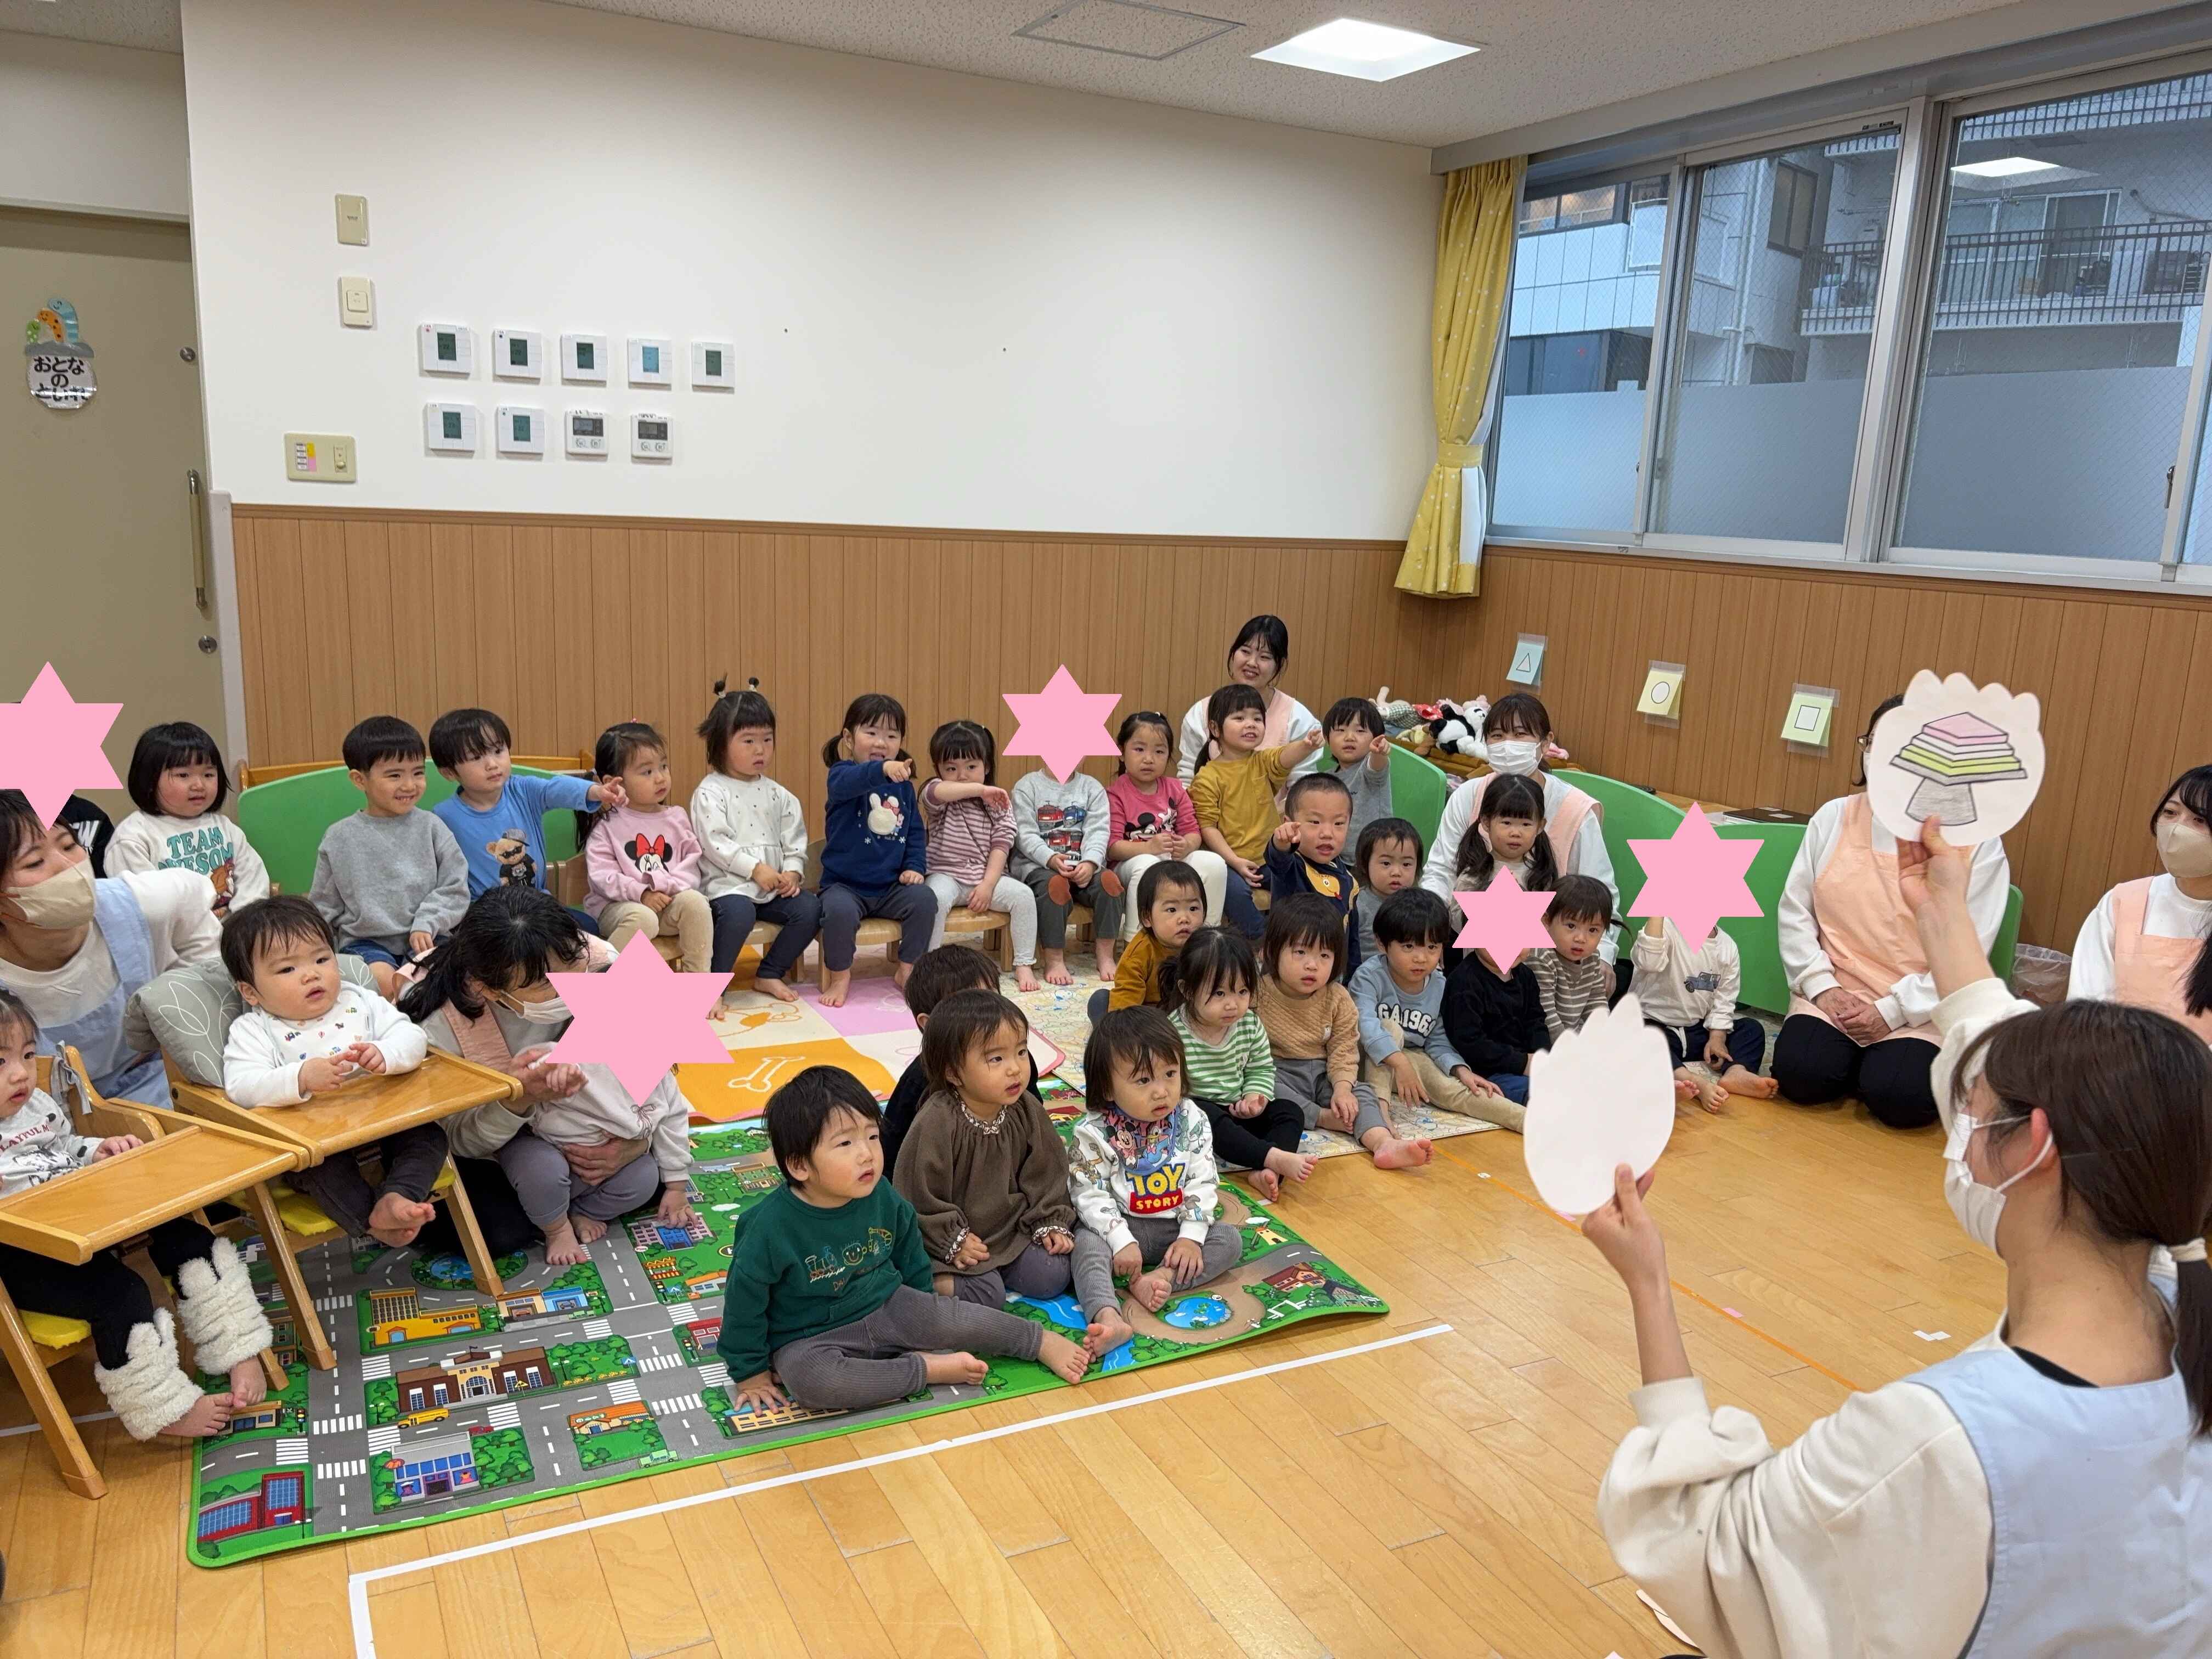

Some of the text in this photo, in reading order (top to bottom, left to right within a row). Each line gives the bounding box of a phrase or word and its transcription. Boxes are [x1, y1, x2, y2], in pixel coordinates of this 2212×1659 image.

[33, 357, 84, 375] おとな
[50, 374, 69, 388] の
[167, 826, 224, 859] TEAM
[0, 1127, 42, 1152] LAYFUL
[1125, 1163, 1185, 1197] TOY
[1136, 1195, 1180, 1210] STORY
